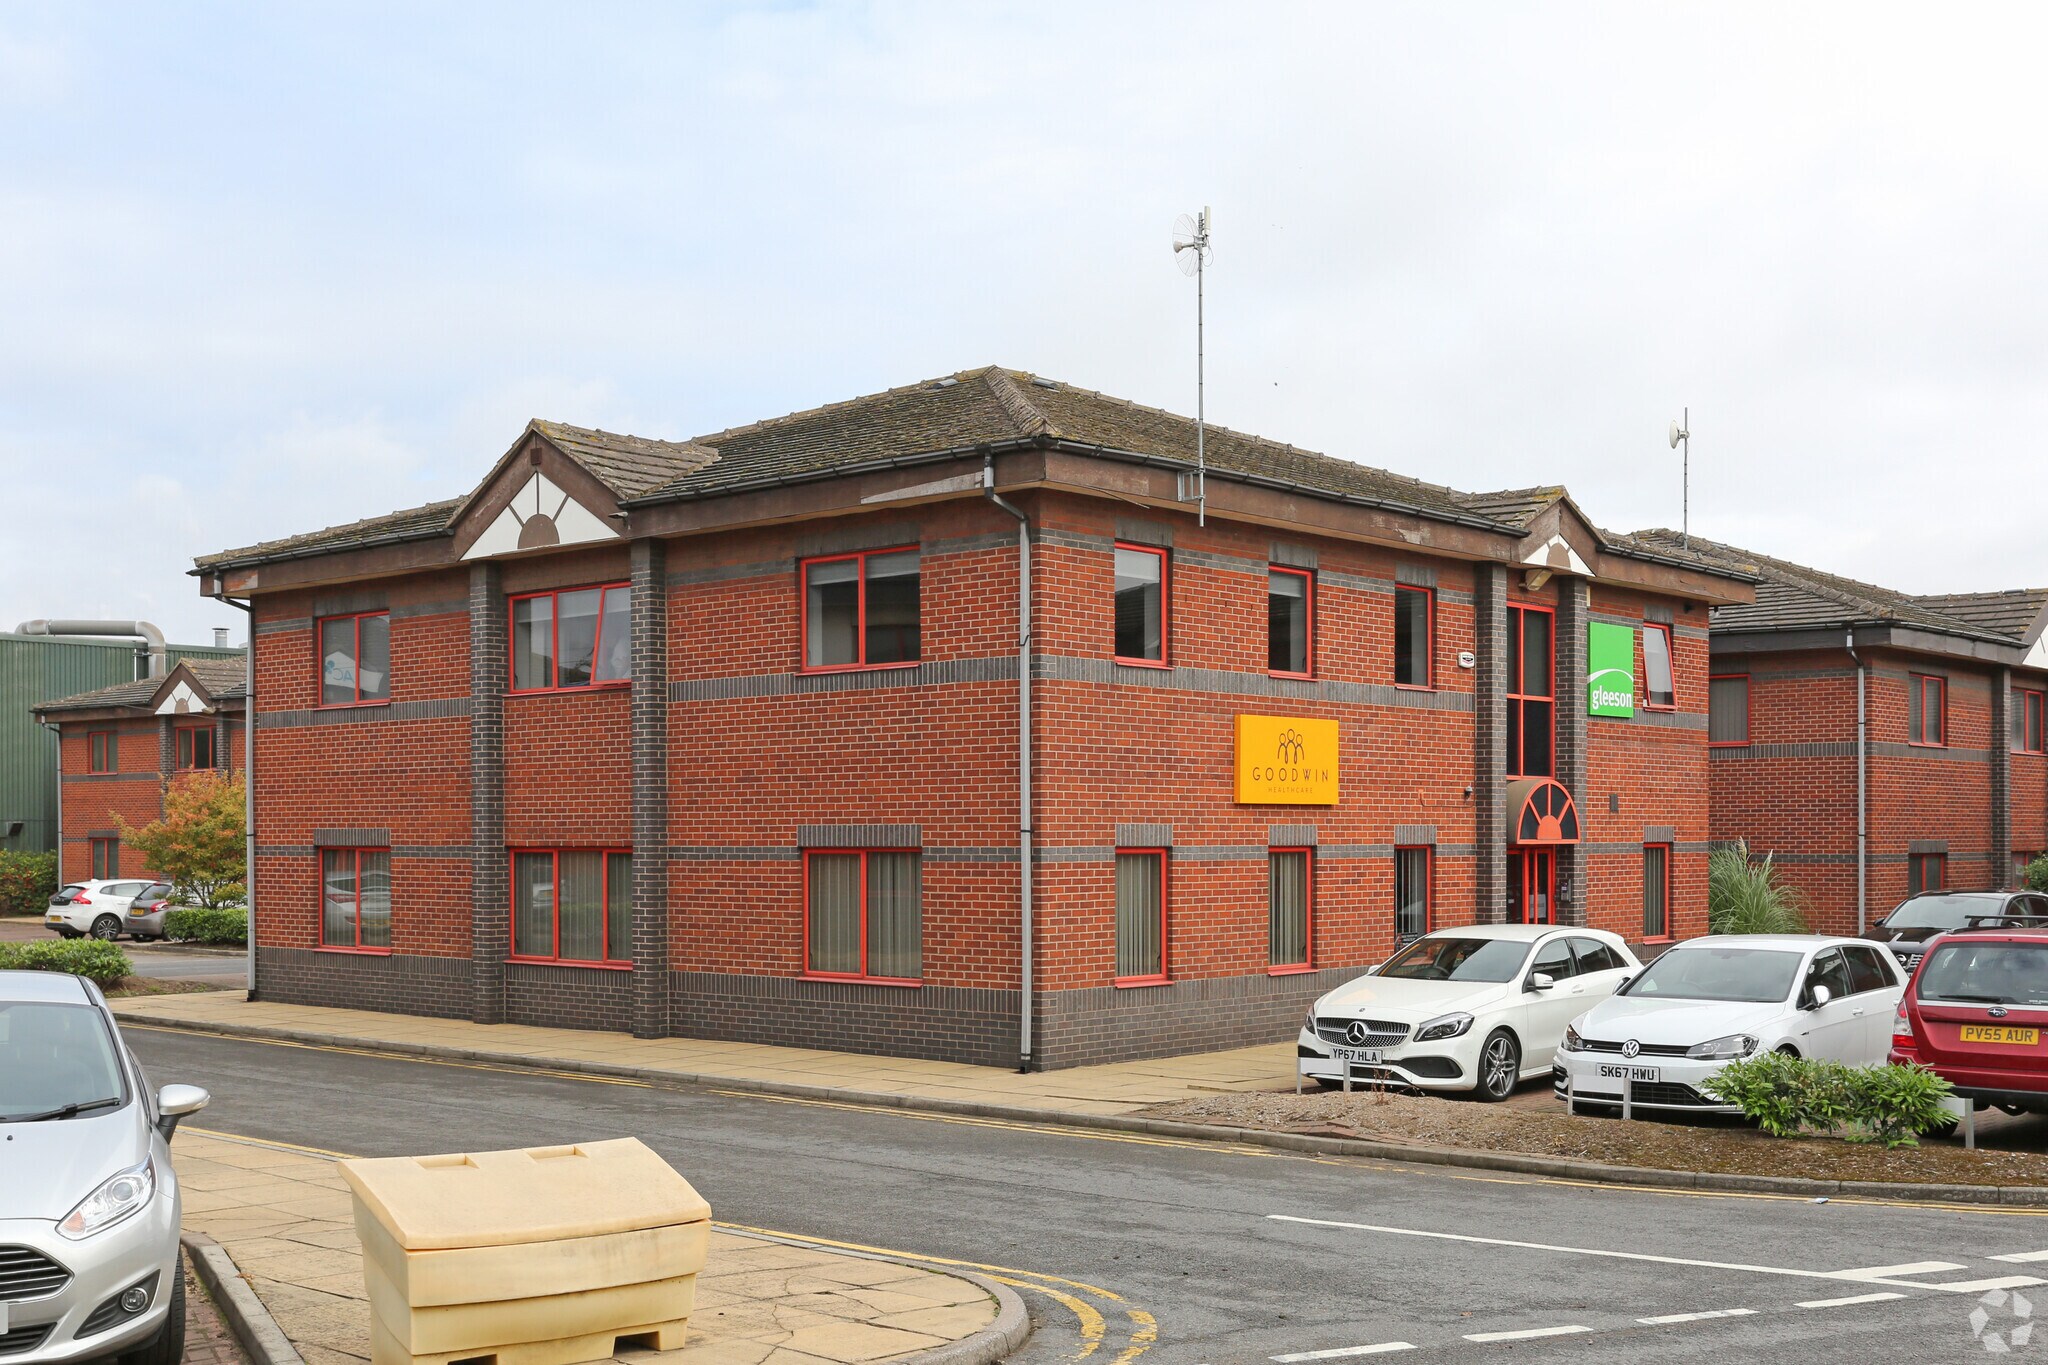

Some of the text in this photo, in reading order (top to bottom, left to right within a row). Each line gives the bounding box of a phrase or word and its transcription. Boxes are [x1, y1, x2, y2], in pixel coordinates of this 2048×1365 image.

[1592, 685, 1632, 710] gleeson
[1252, 766, 1329, 782] GOODWIN
[1267, 786, 1313, 794] HEALTHCARE
[1965, 1027, 2033, 1042] PV55 AUR
[1332, 1048, 1378, 1062] YP67 HLA
[1600, 1065, 1655, 1081] SK67 HWU
